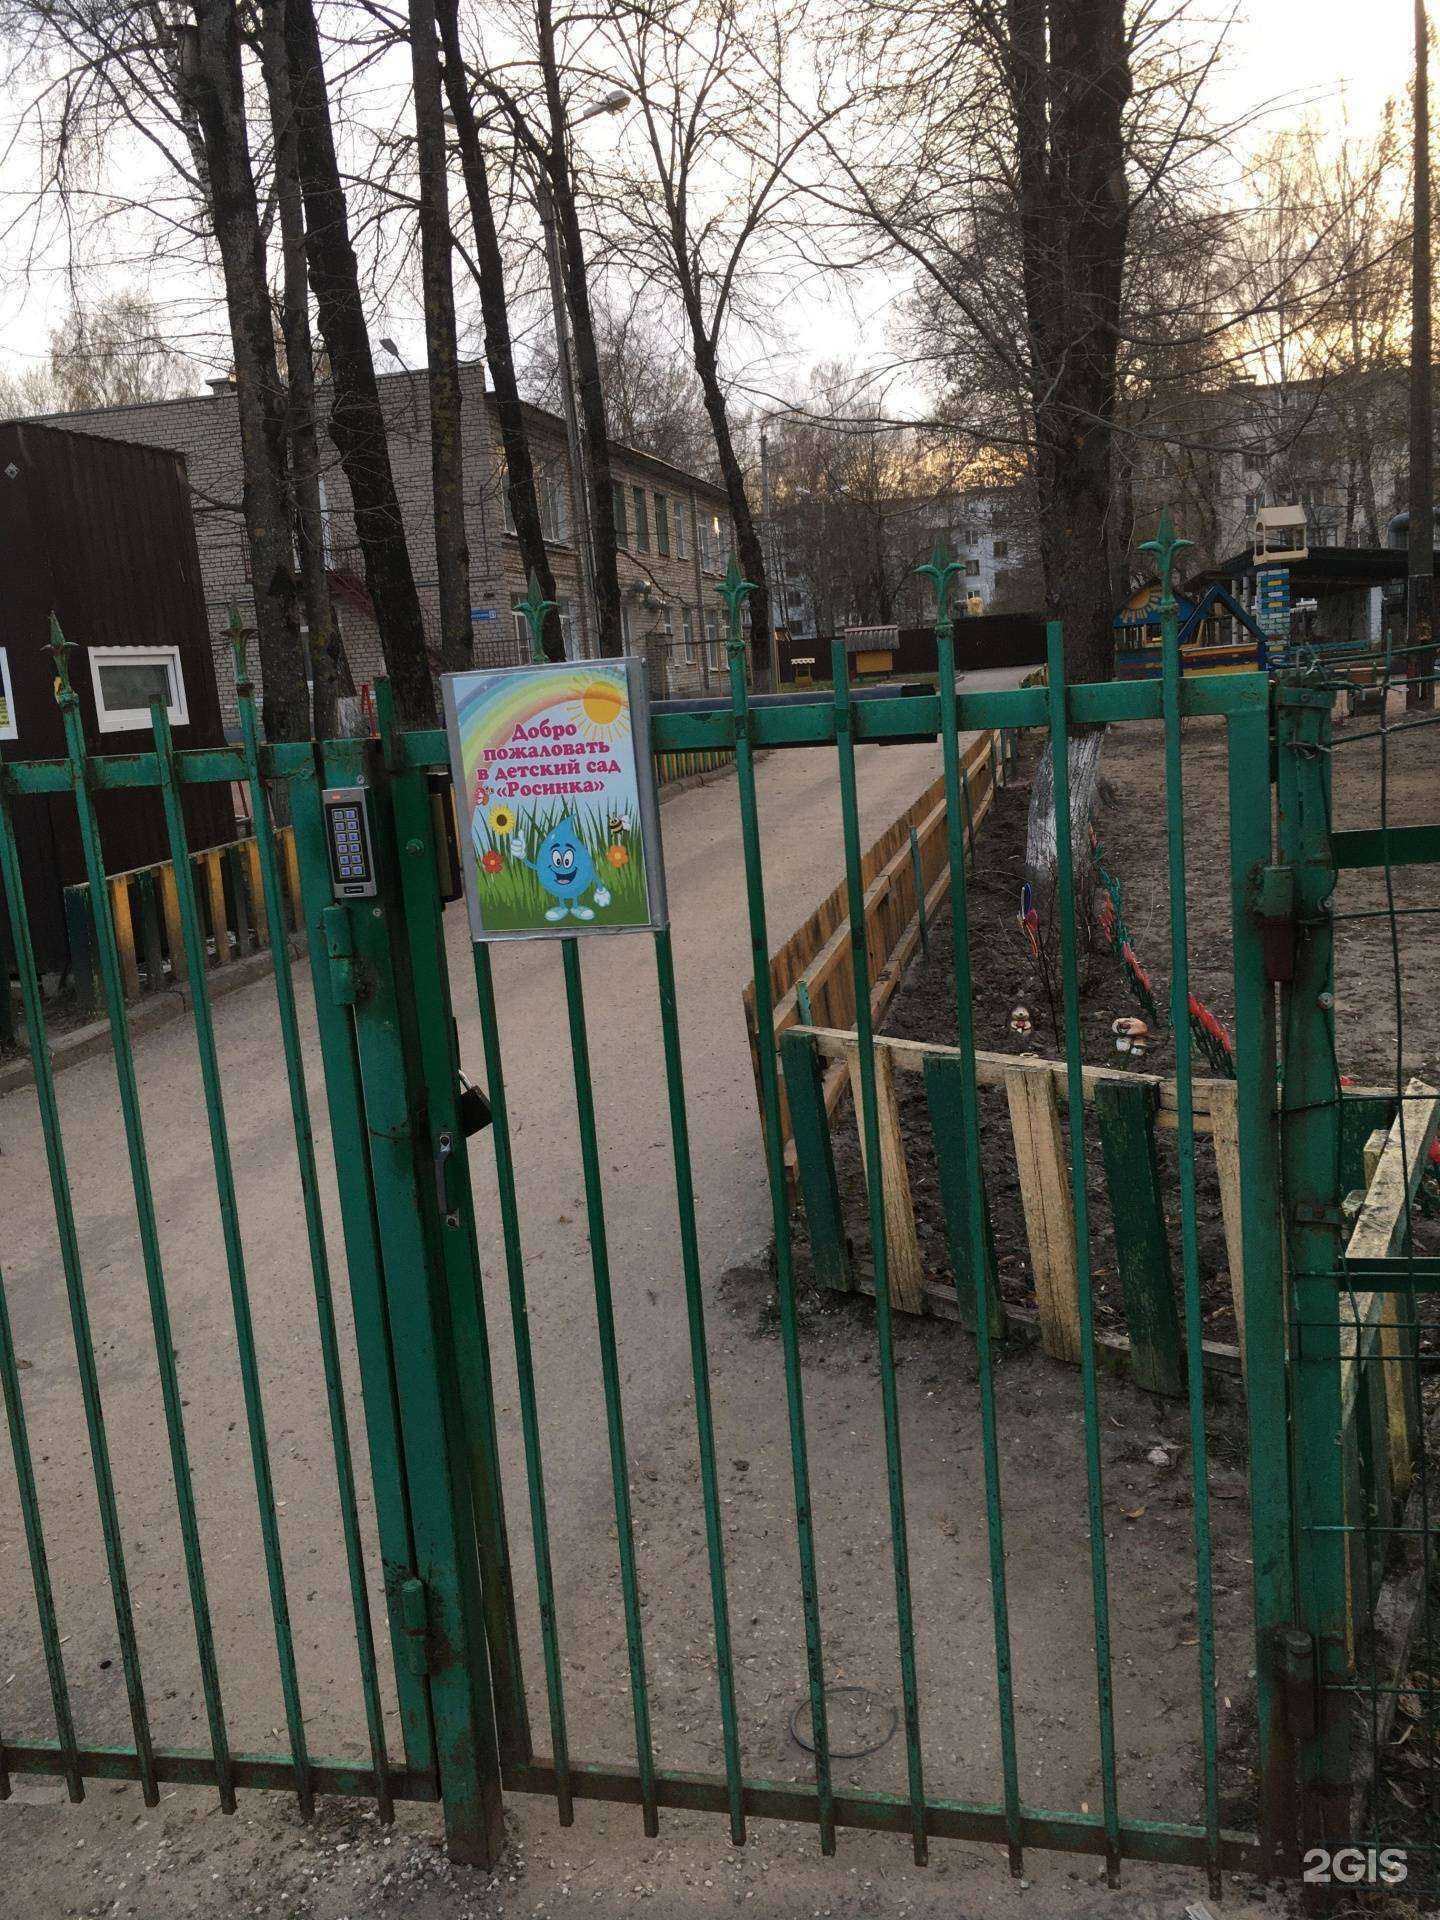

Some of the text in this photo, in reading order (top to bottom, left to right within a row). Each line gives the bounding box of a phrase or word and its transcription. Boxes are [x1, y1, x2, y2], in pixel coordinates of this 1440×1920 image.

[511, 718, 577, 742] Добро
[483, 741, 610, 761] пожаловать
[477, 758, 622, 781] в детский сад
[496, 780, 605, 798] «Росинка»
